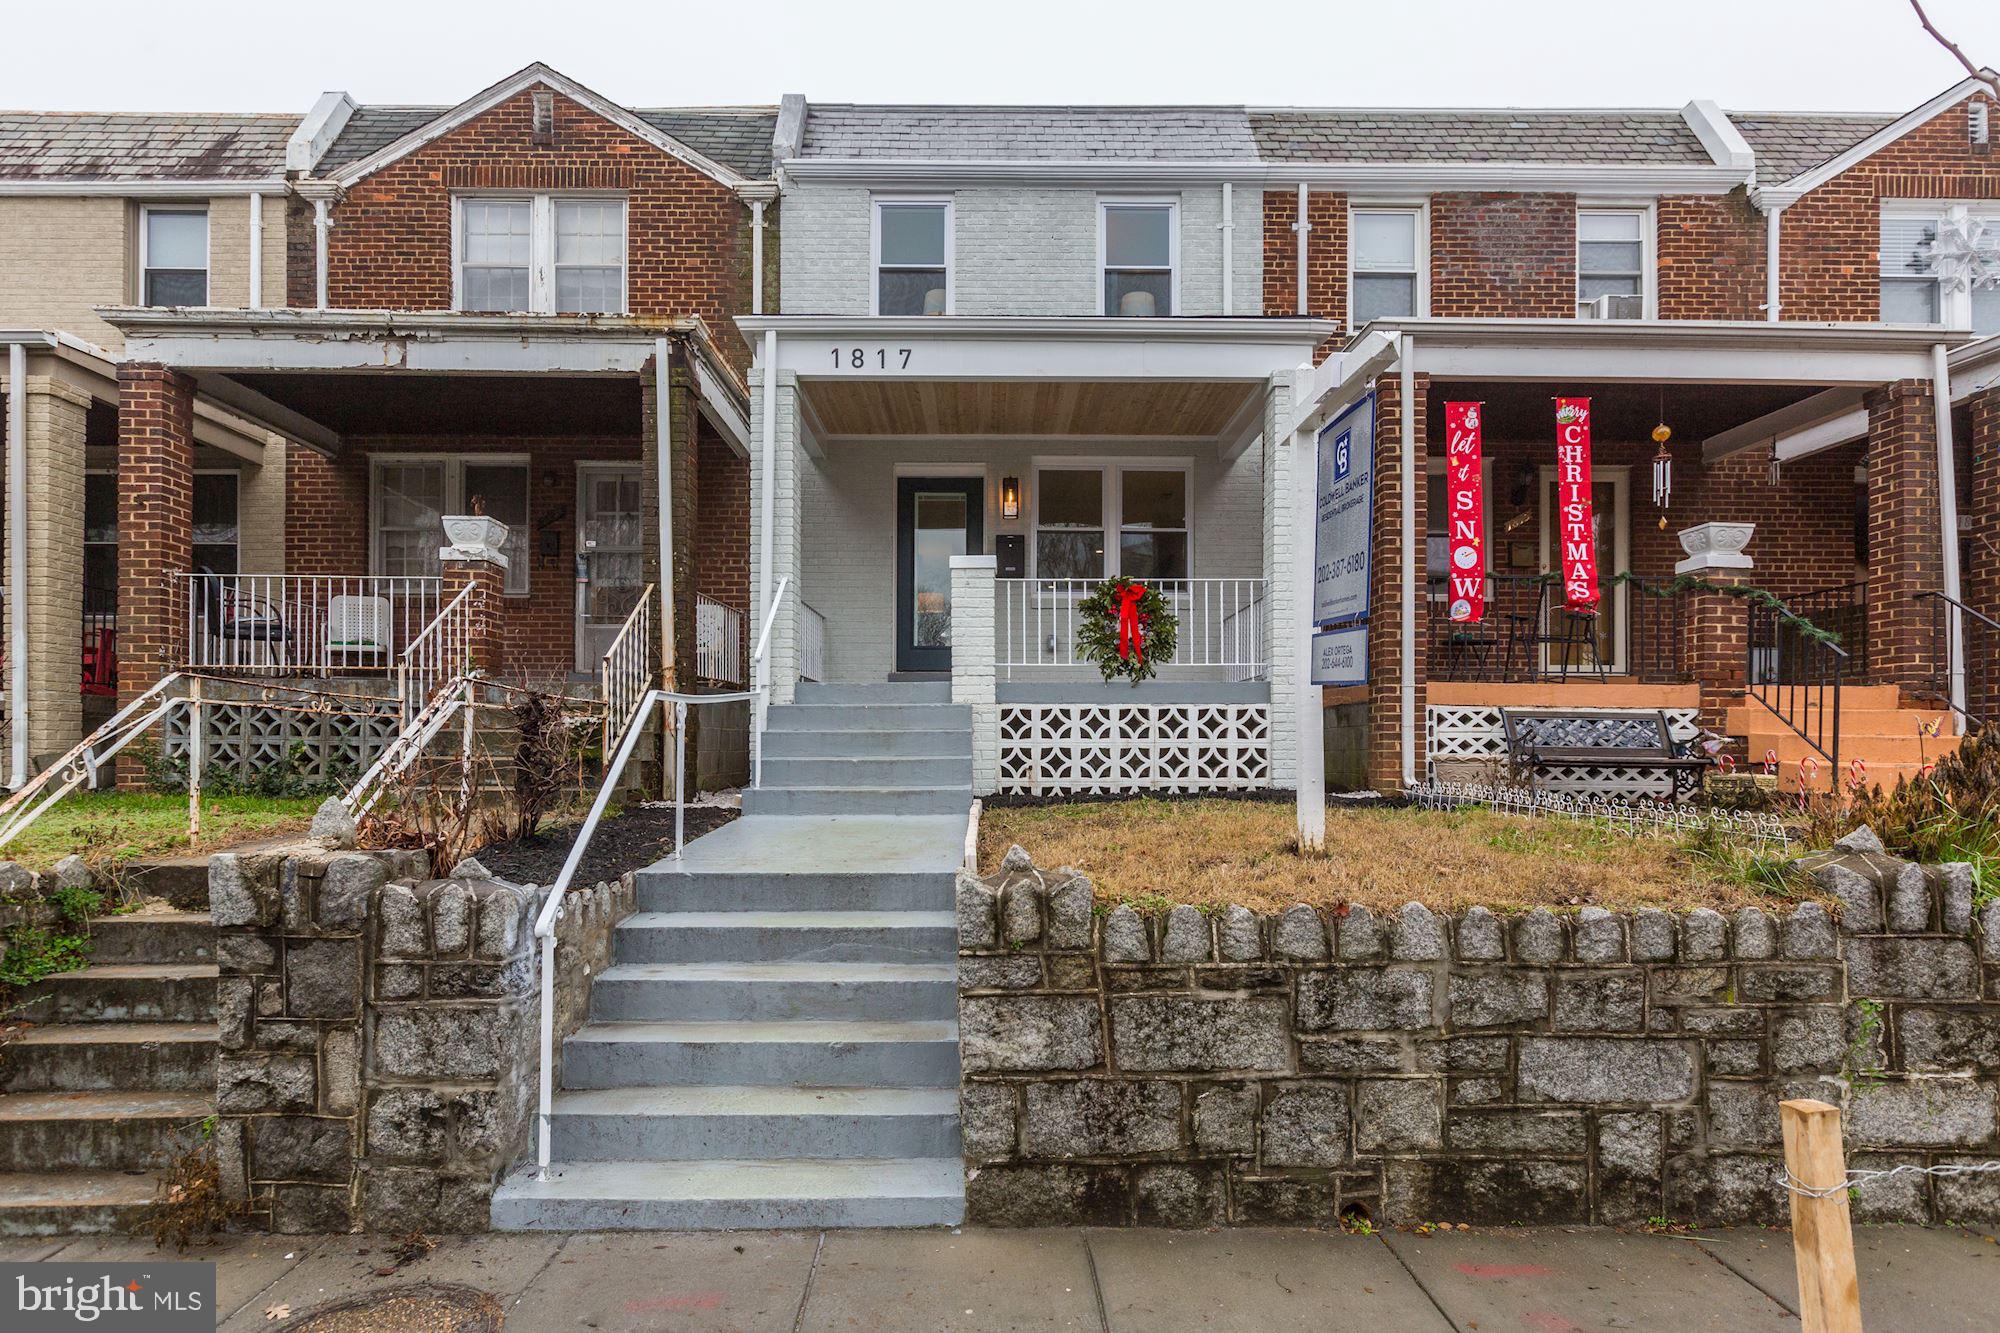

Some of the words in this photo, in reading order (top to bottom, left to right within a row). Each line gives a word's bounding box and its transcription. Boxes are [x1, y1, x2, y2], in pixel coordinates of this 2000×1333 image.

[831, 348, 912, 369] 1817
[1451, 430, 1476, 454] let
[1457, 463, 1470, 482] it
[1319, 486, 1344, 508] COLDWELL
[1345, 472, 1369, 494] BANKER
[1564, 425, 1590, 598] CHRISTMAS
[1317, 551, 1365, 584] 202-387-6180
[1323, 646, 1334, 656] ALEX
